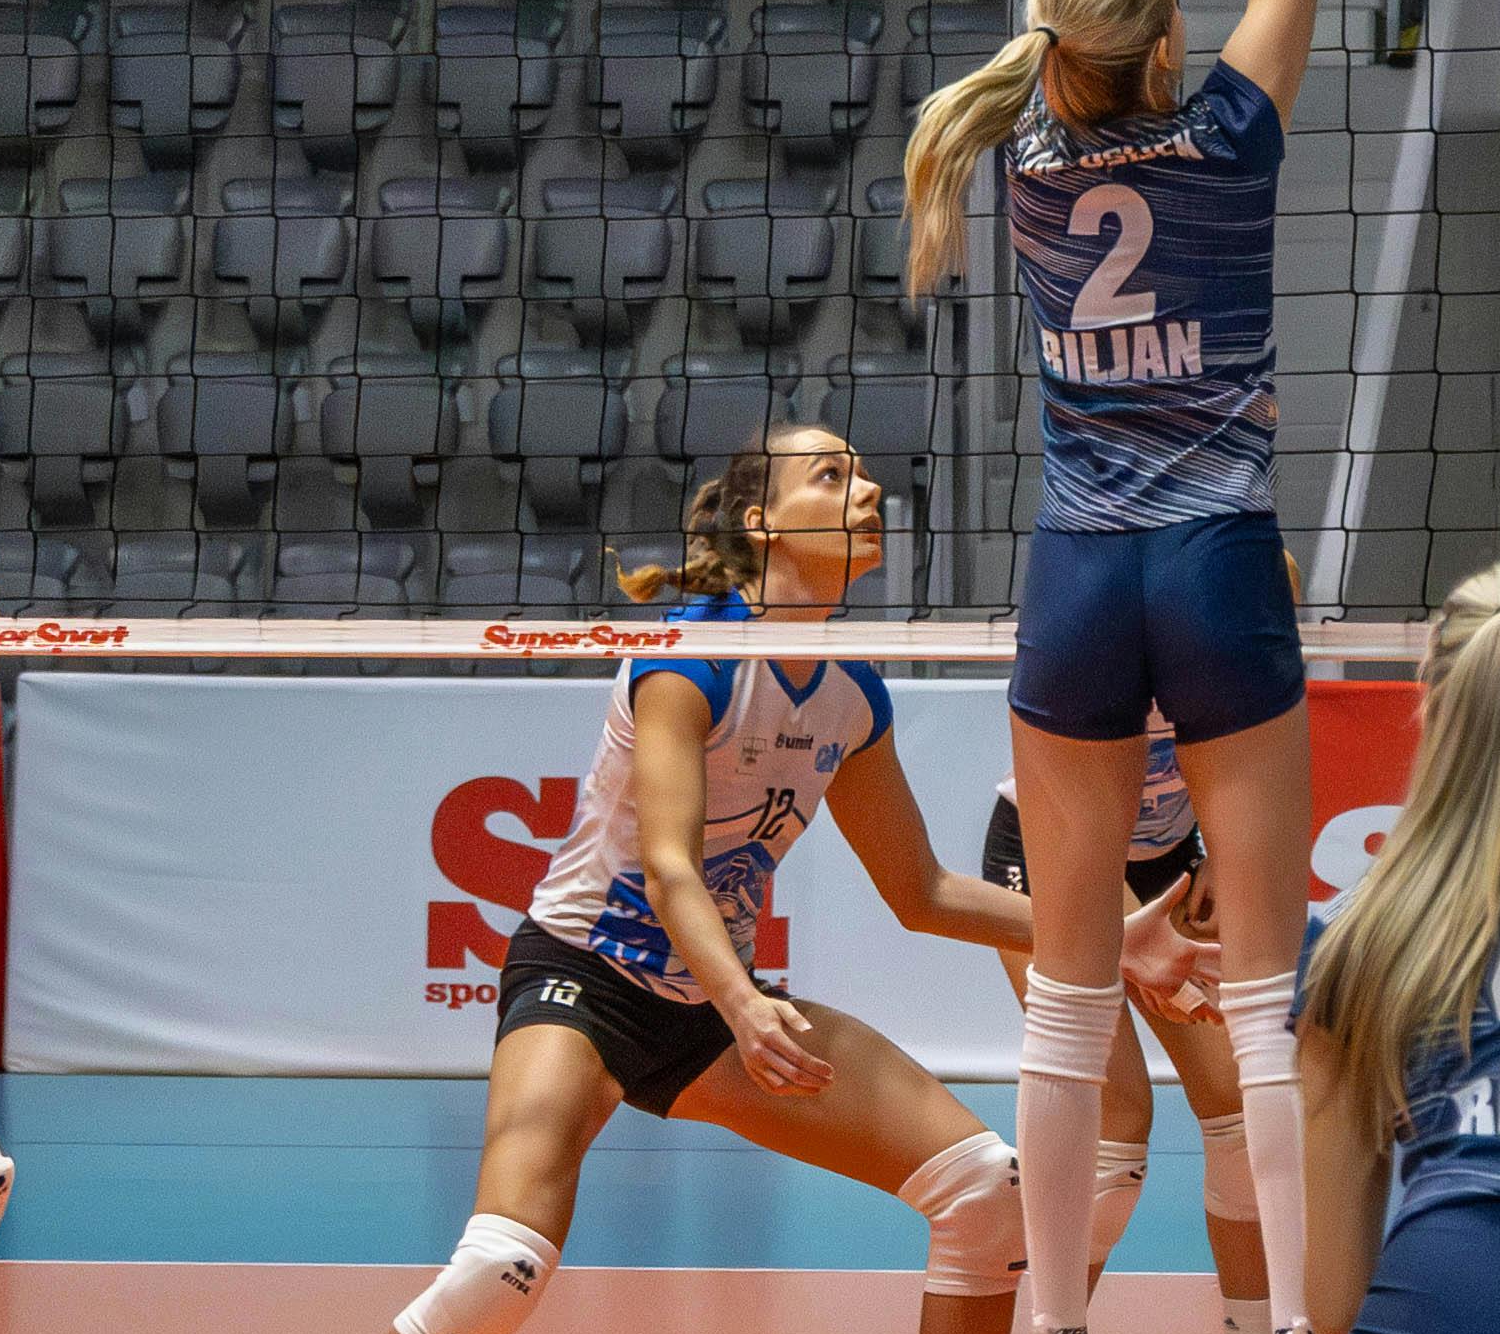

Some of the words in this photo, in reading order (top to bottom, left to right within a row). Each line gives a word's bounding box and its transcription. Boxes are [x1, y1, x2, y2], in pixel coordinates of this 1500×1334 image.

[1067, 183, 1157, 331] 2
[482, 624, 684, 655] SuperSport
[747, 787, 796, 841] 12
[540, 978, 583, 1008] 12
